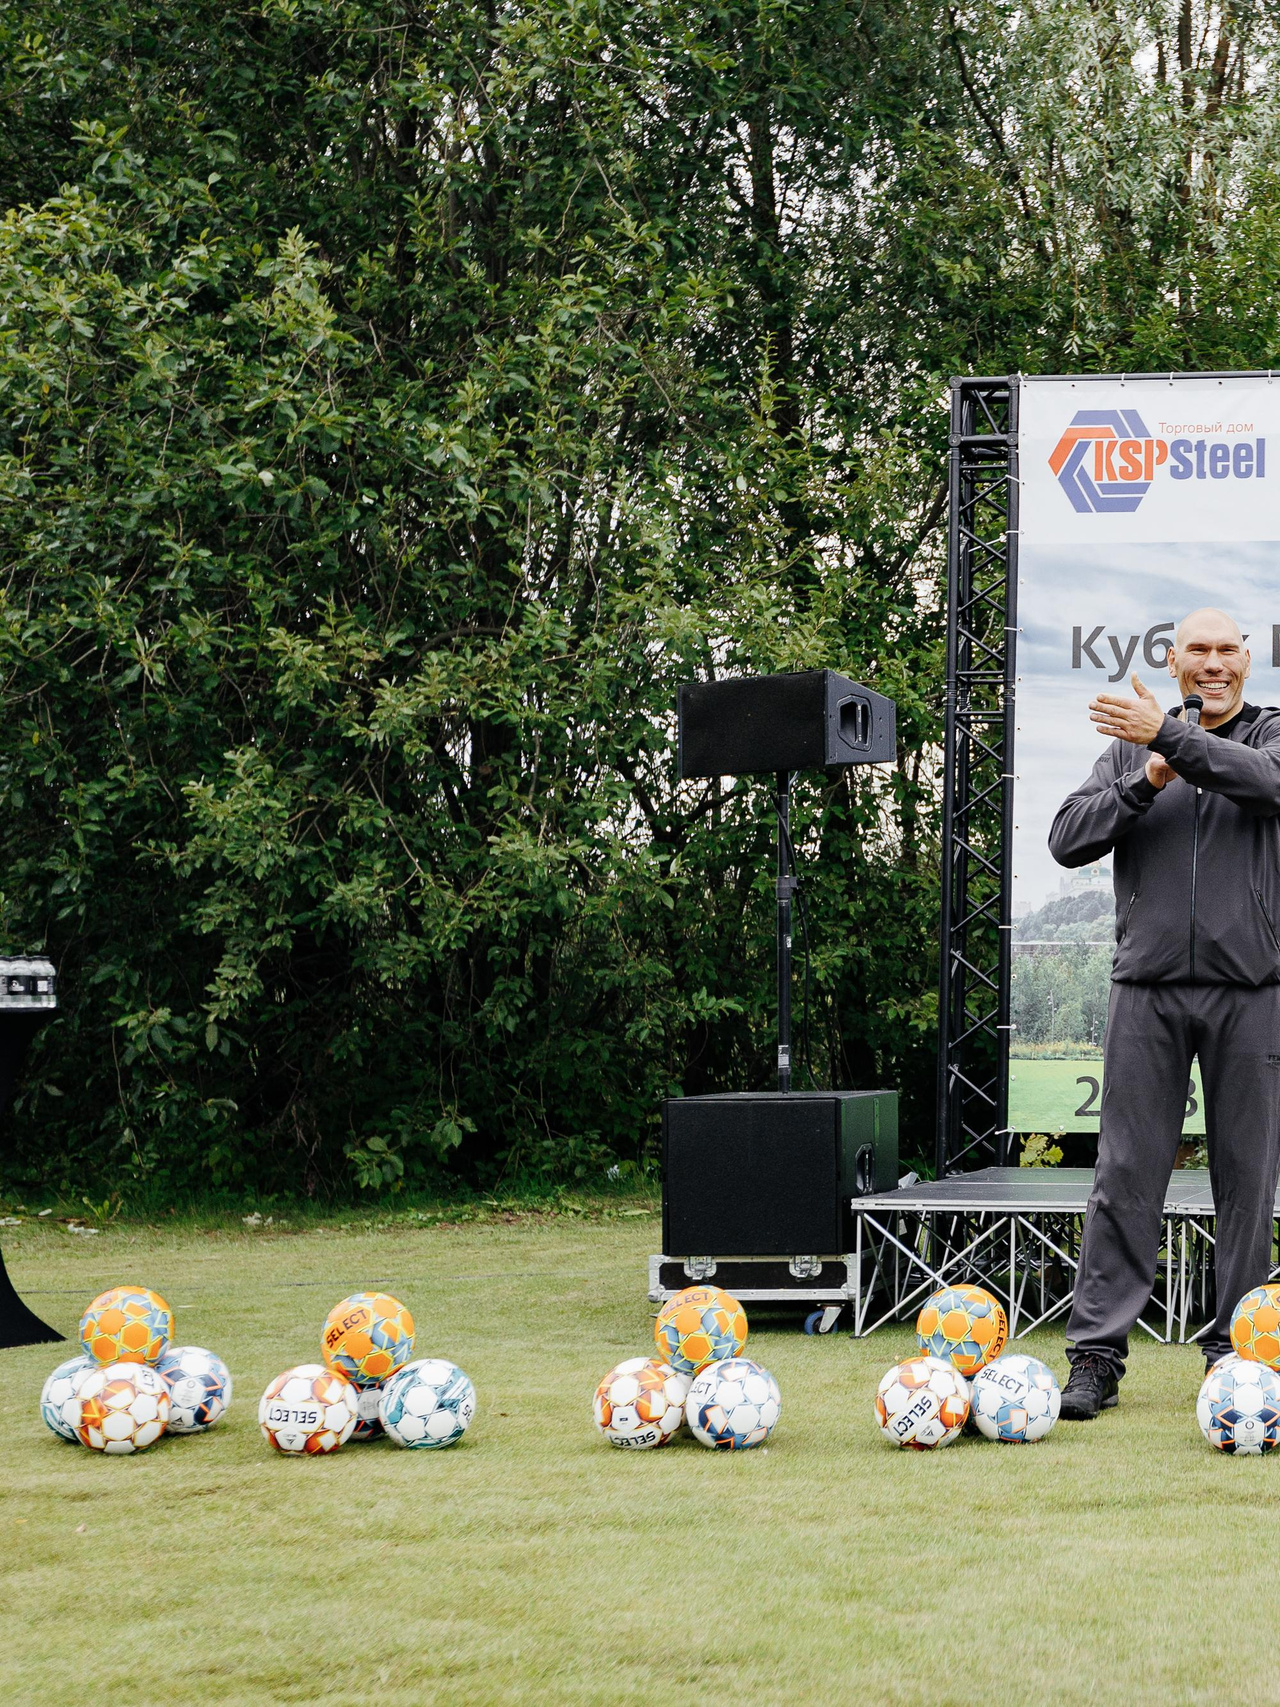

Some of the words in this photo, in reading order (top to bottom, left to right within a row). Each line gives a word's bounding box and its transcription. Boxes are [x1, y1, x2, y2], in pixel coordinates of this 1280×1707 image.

[1158, 421, 1222, 436] Торговый
[1226, 422, 1254, 434] дом
[1071, 622, 1250, 683] Куб
[662, 1292, 710, 1316] SELECT
[326, 1309, 367, 1348] SELECT
[989, 1310, 1005, 1359] SELECT
[980, 1368, 1025, 1394] SELECT
[269, 1407, 317, 1424] SELECT
[893, 1396, 932, 1436] SELECT
[609, 1430, 656, 1446] SELECT
